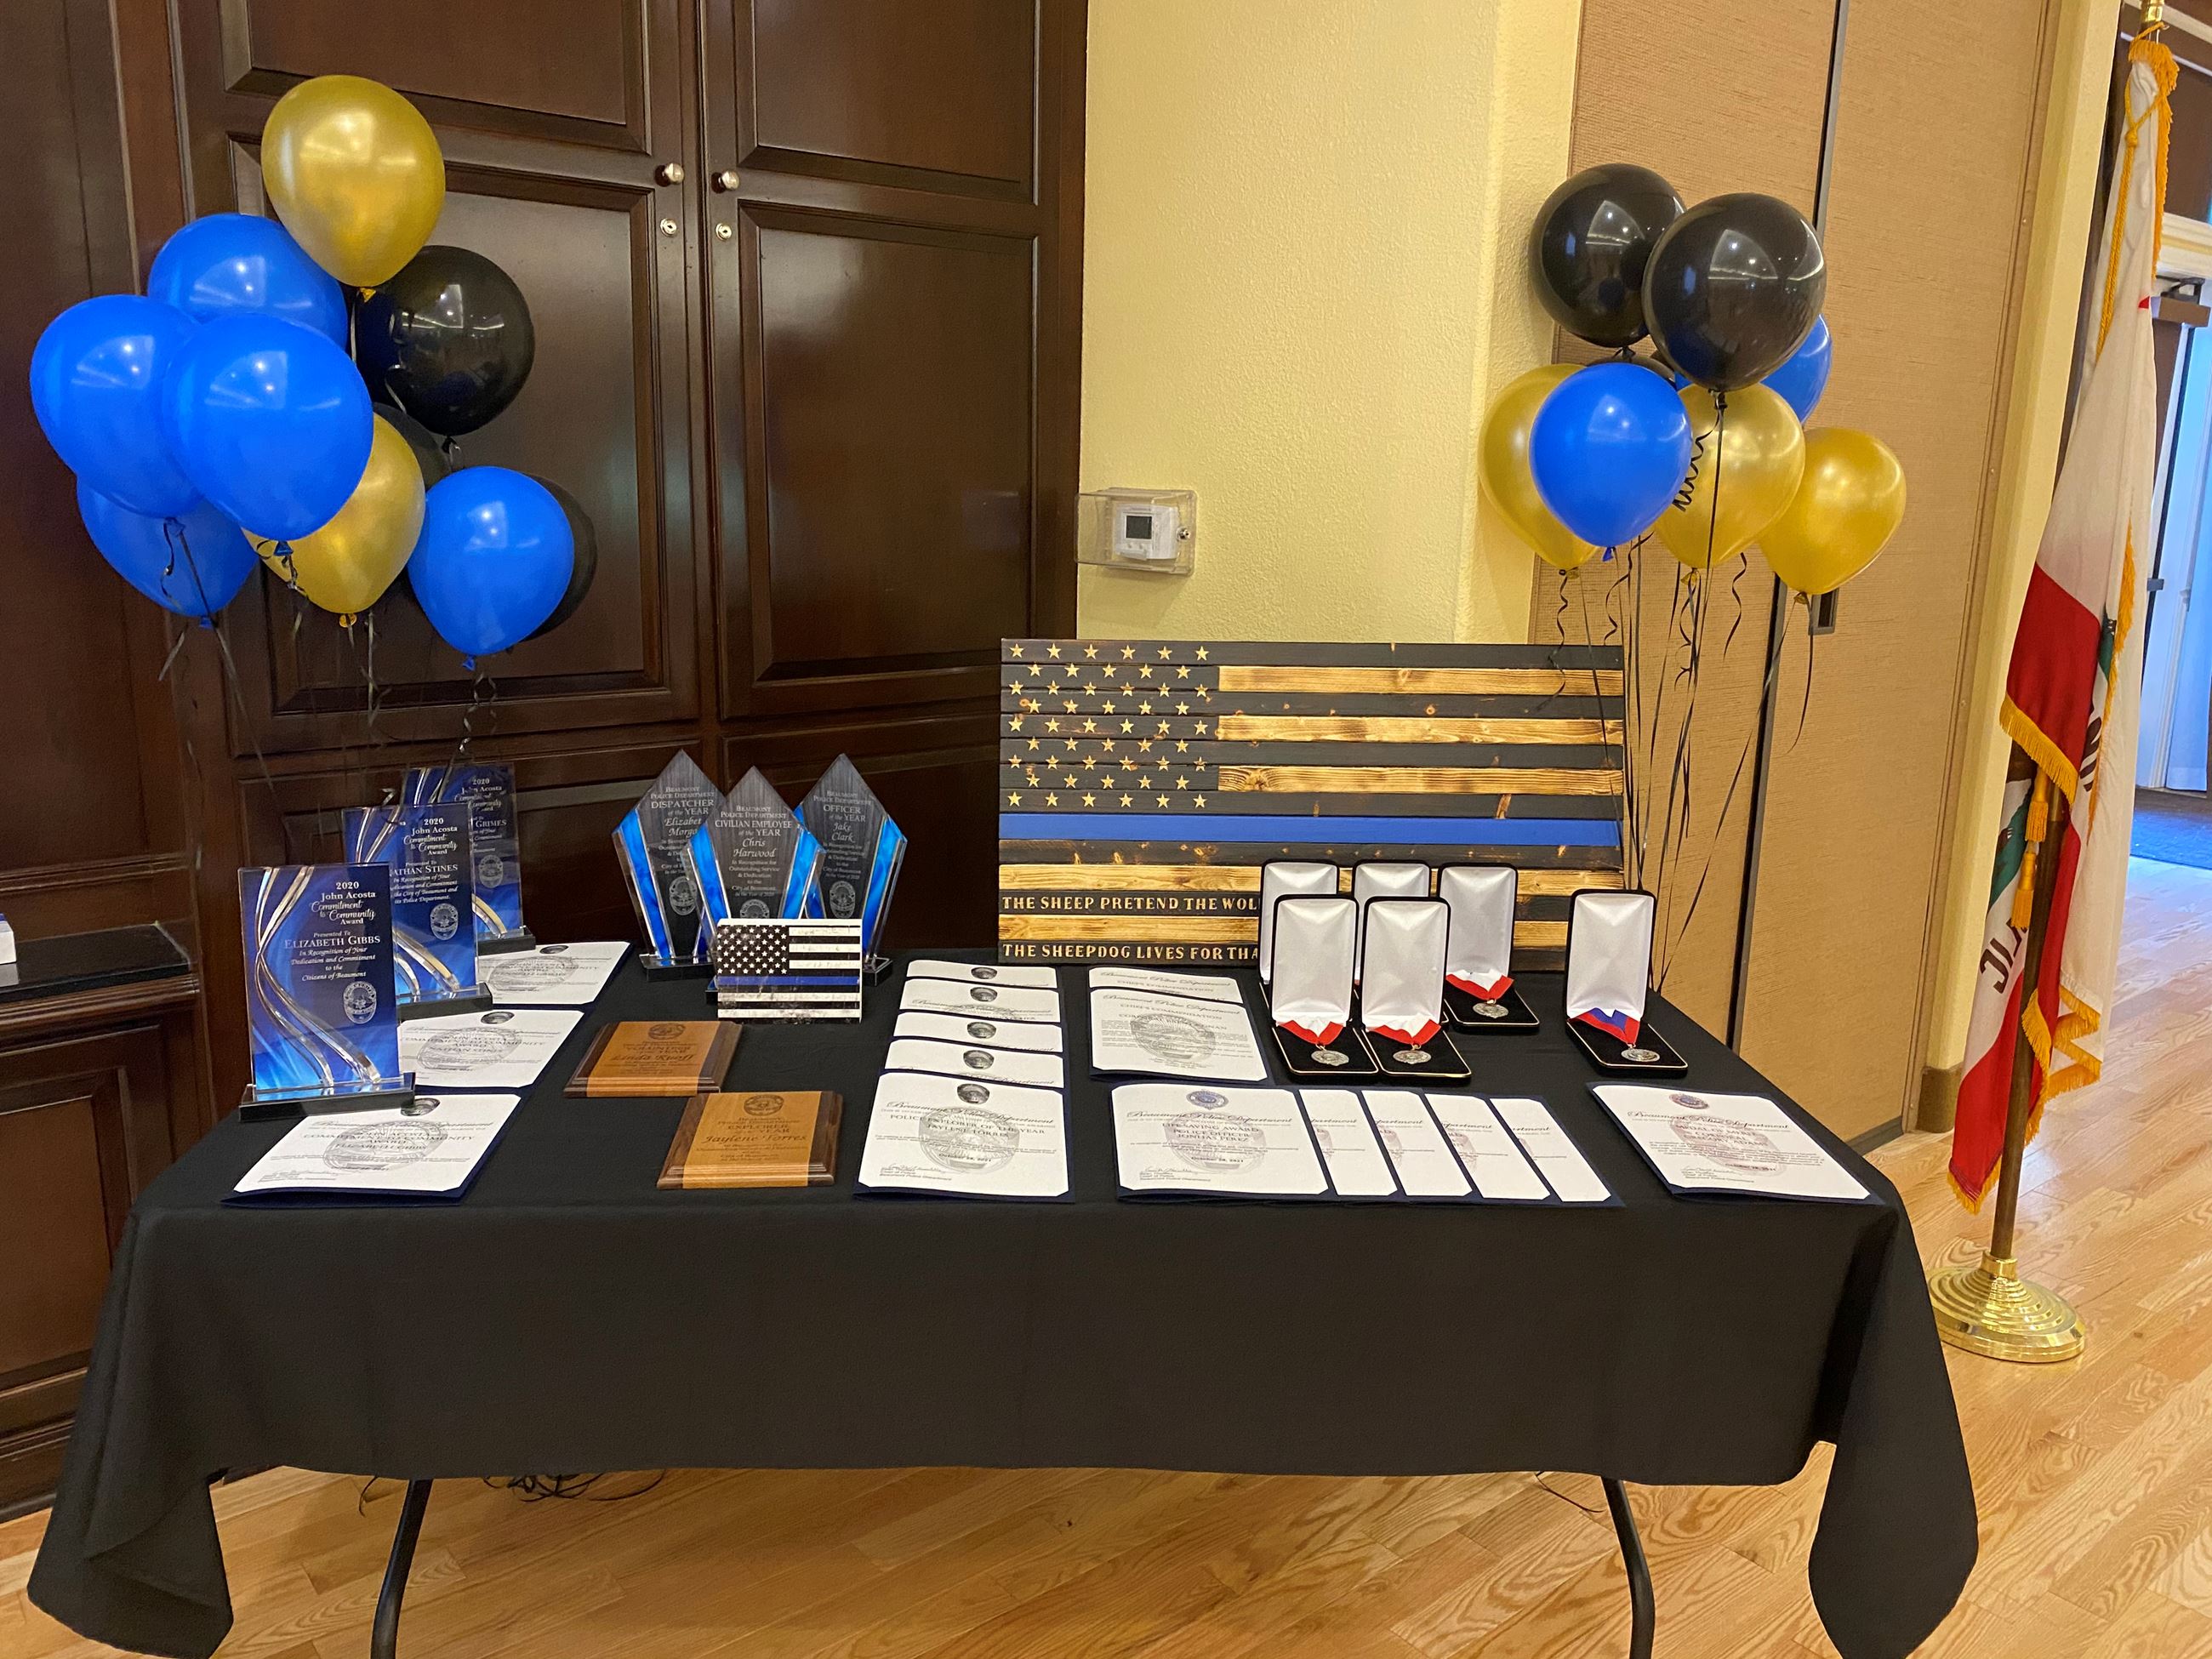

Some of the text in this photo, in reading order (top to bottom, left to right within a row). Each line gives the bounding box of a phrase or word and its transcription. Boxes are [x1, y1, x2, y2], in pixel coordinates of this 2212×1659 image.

[652, 800, 714, 809] DISPATCHER
[824, 805, 861, 813] OFFICER
[665, 817, 702, 826] Elizabet
[751, 820, 793, 829] EMPLOYEE
[833, 822, 851, 831] Jake
[412, 827, 430, 836] John
[669, 828, 698, 838] Morga
[403, 834, 448, 845] Commitment
[743, 837, 766, 847] Chris
[831, 832, 855, 843] Clark
[733, 847, 777, 858] Harwood
[425, 864, 458, 873] STINES
[336, 881, 359, 890] 2020
[321, 892, 343, 902] John
[310, 900, 364, 912] Commitment
[1002, 897, 1259, 911] THE SHEEP PRETEND THE WOL
[328, 909, 376, 921] Community
[284, 936, 381, 949] ELIZABETH GIBBS
[307, 948, 344, 956] Recognition
[1002, 944, 1257, 961] THE SHEEPDOG LIVES FOR THA
[887, 1101, 948, 1113] Beaumont
[985, 1113, 1055, 1124] Department
[1126, 1111, 1191, 1120] Beaumont
[1225, 1115, 1293, 1124] Department
[1627, 1111, 1688, 1120] Beaumont
[1725, 1120, 1789, 1130] Department
